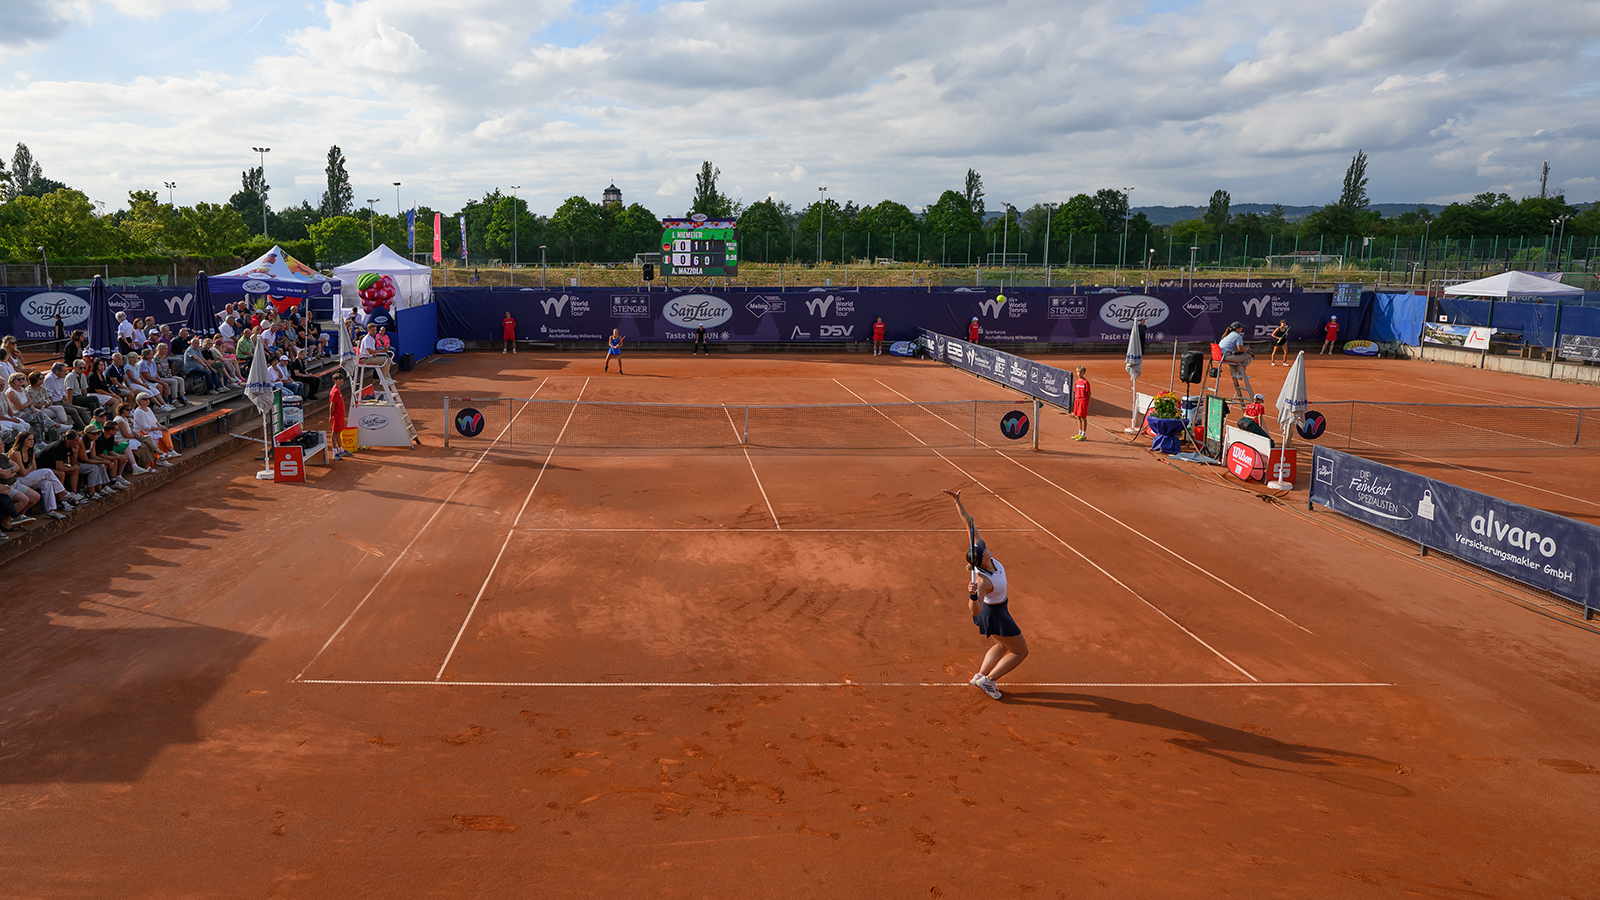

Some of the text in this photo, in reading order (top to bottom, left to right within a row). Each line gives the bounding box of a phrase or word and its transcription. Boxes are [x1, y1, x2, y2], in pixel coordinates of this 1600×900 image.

[680, 241, 709, 251] 0 1 1
[680, 255, 710, 266] 0 6 0
[27, 298, 86, 321] SanLucar
[612, 305, 648, 313] STENGER
[669, 300, 728, 322] SanLucar
[1050, 306, 1085, 314] STENGER
[1106, 301, 1165, 323] SanLucar
[25, 330, 47, 338] Taste
[820, 325, 854, 336] DSV
[1232, 445, 1253, 466] Wilson
[1359, 469, 1371, 481] DIE
[1348, 477, 1392, 496] Feinkost
[1357, 492, 1398, 513] SPEZIALISTEN
[1470, 509, 1557, 558] alvaro
[1455, 533, 1573, 582] Versicherungsmakler GmbH
